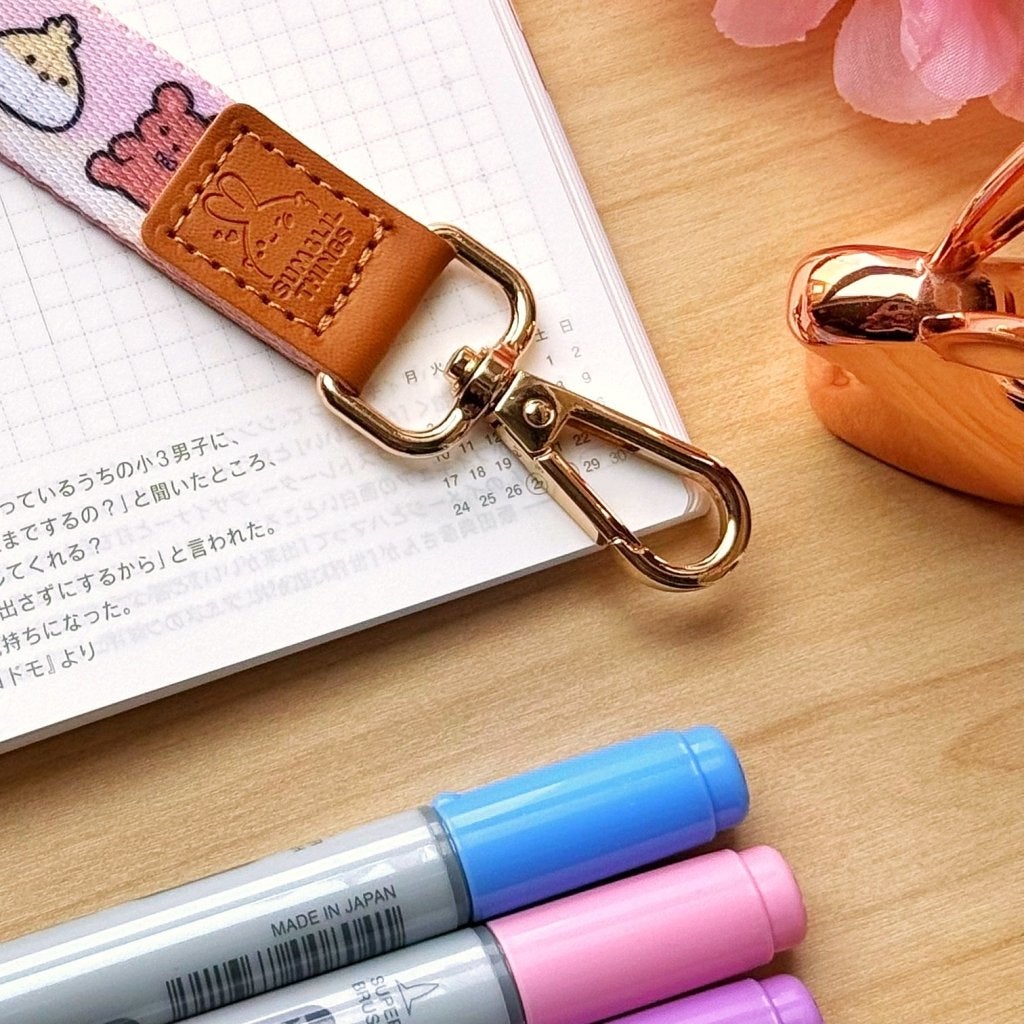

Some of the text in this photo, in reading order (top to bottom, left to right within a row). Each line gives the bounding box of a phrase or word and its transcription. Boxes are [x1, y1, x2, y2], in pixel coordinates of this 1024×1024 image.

[294, 226, 356, 302] THINGS
[404, 318, 574, 385] 月 火 土 日
[545, 345, 582, 366] 1 2
[581, 371, 592, 384] 9
[442, 474, 459, 489] 17
[469, 465, 487, 480] 18
[495, 457, 512, 472] 19
[572, 432, 591, 446] 22
[458, 440, 475, 454] 11
[452, 501, 471, 516] 24
[478, 492, 497, 507] 25
[505, 483, 523, 499] 26
[583, 457, 601, 472] 29
[270, 885, 397, 938] MADE IN JAPAN
